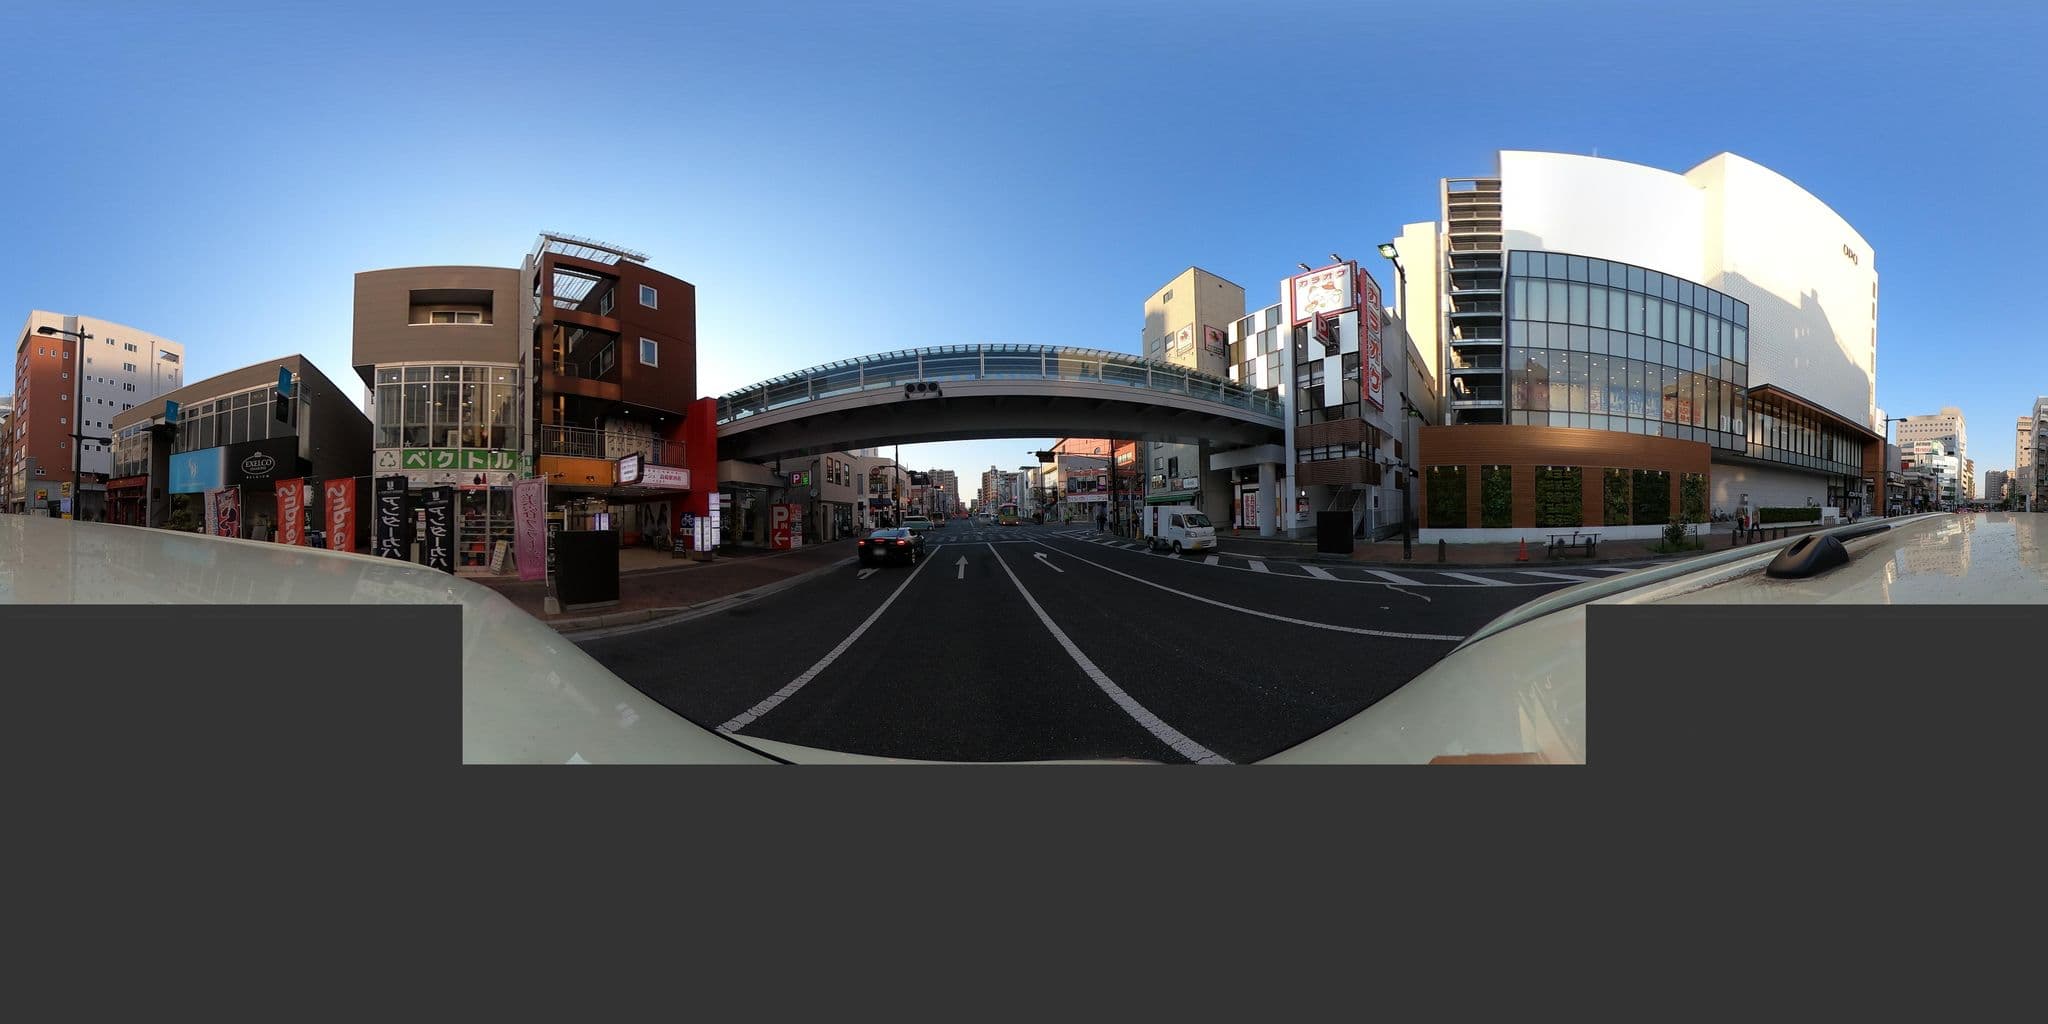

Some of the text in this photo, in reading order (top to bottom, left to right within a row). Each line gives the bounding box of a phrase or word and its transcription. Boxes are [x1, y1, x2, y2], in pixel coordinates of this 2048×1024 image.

[245, 459, 272, 468] EXELCO
[406, 451, 514, 469] ベクトル
[793, 474, 800, 483] P
[773, 506, 789, 529] P
